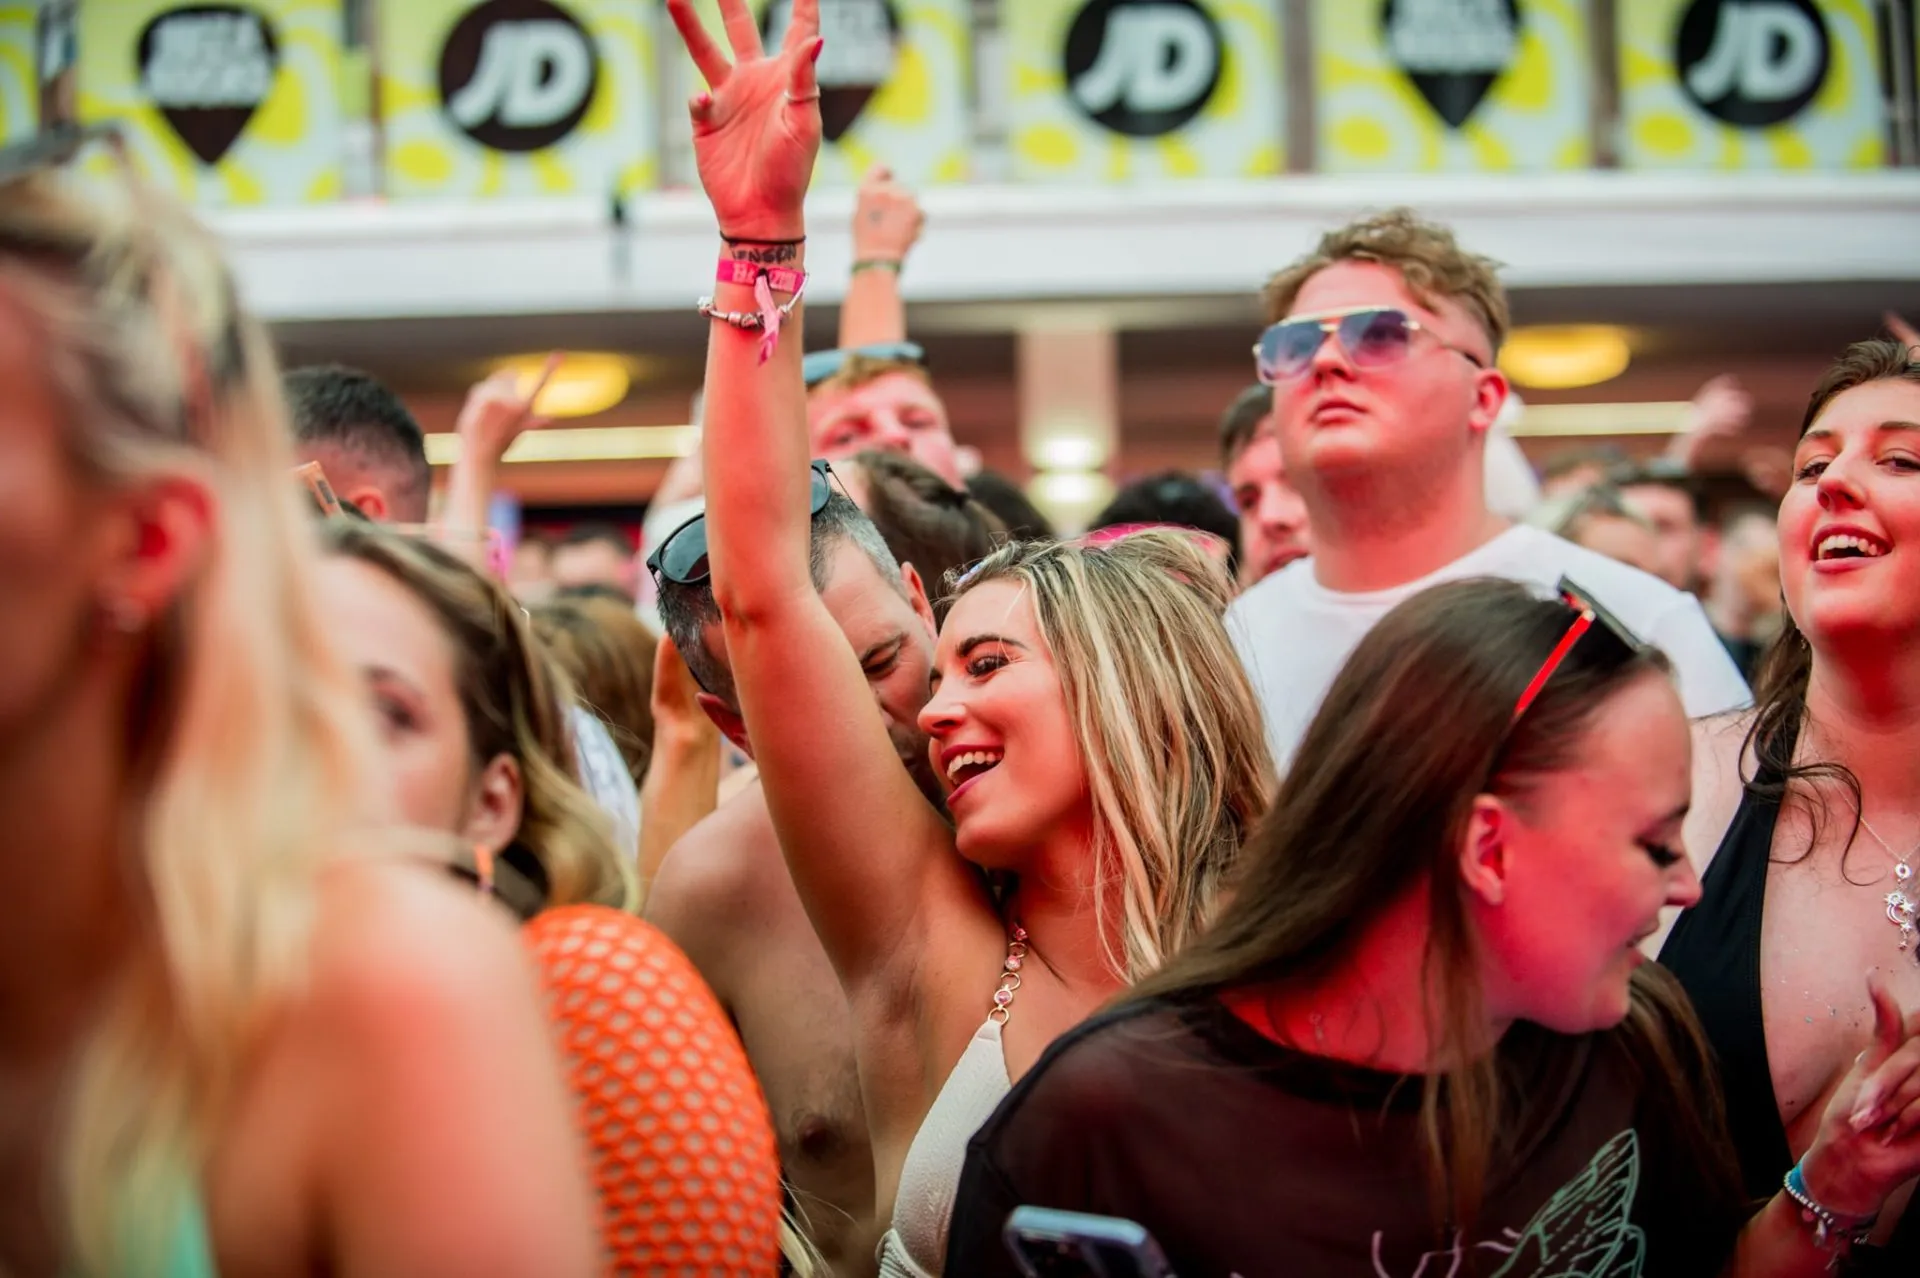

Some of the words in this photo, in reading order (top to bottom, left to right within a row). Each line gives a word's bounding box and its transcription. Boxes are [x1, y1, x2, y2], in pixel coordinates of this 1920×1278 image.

[448, 21, 593, 127] JD
[1075, 4, 1214, 110] JD
[1688, 1, 1817, 99] JD
